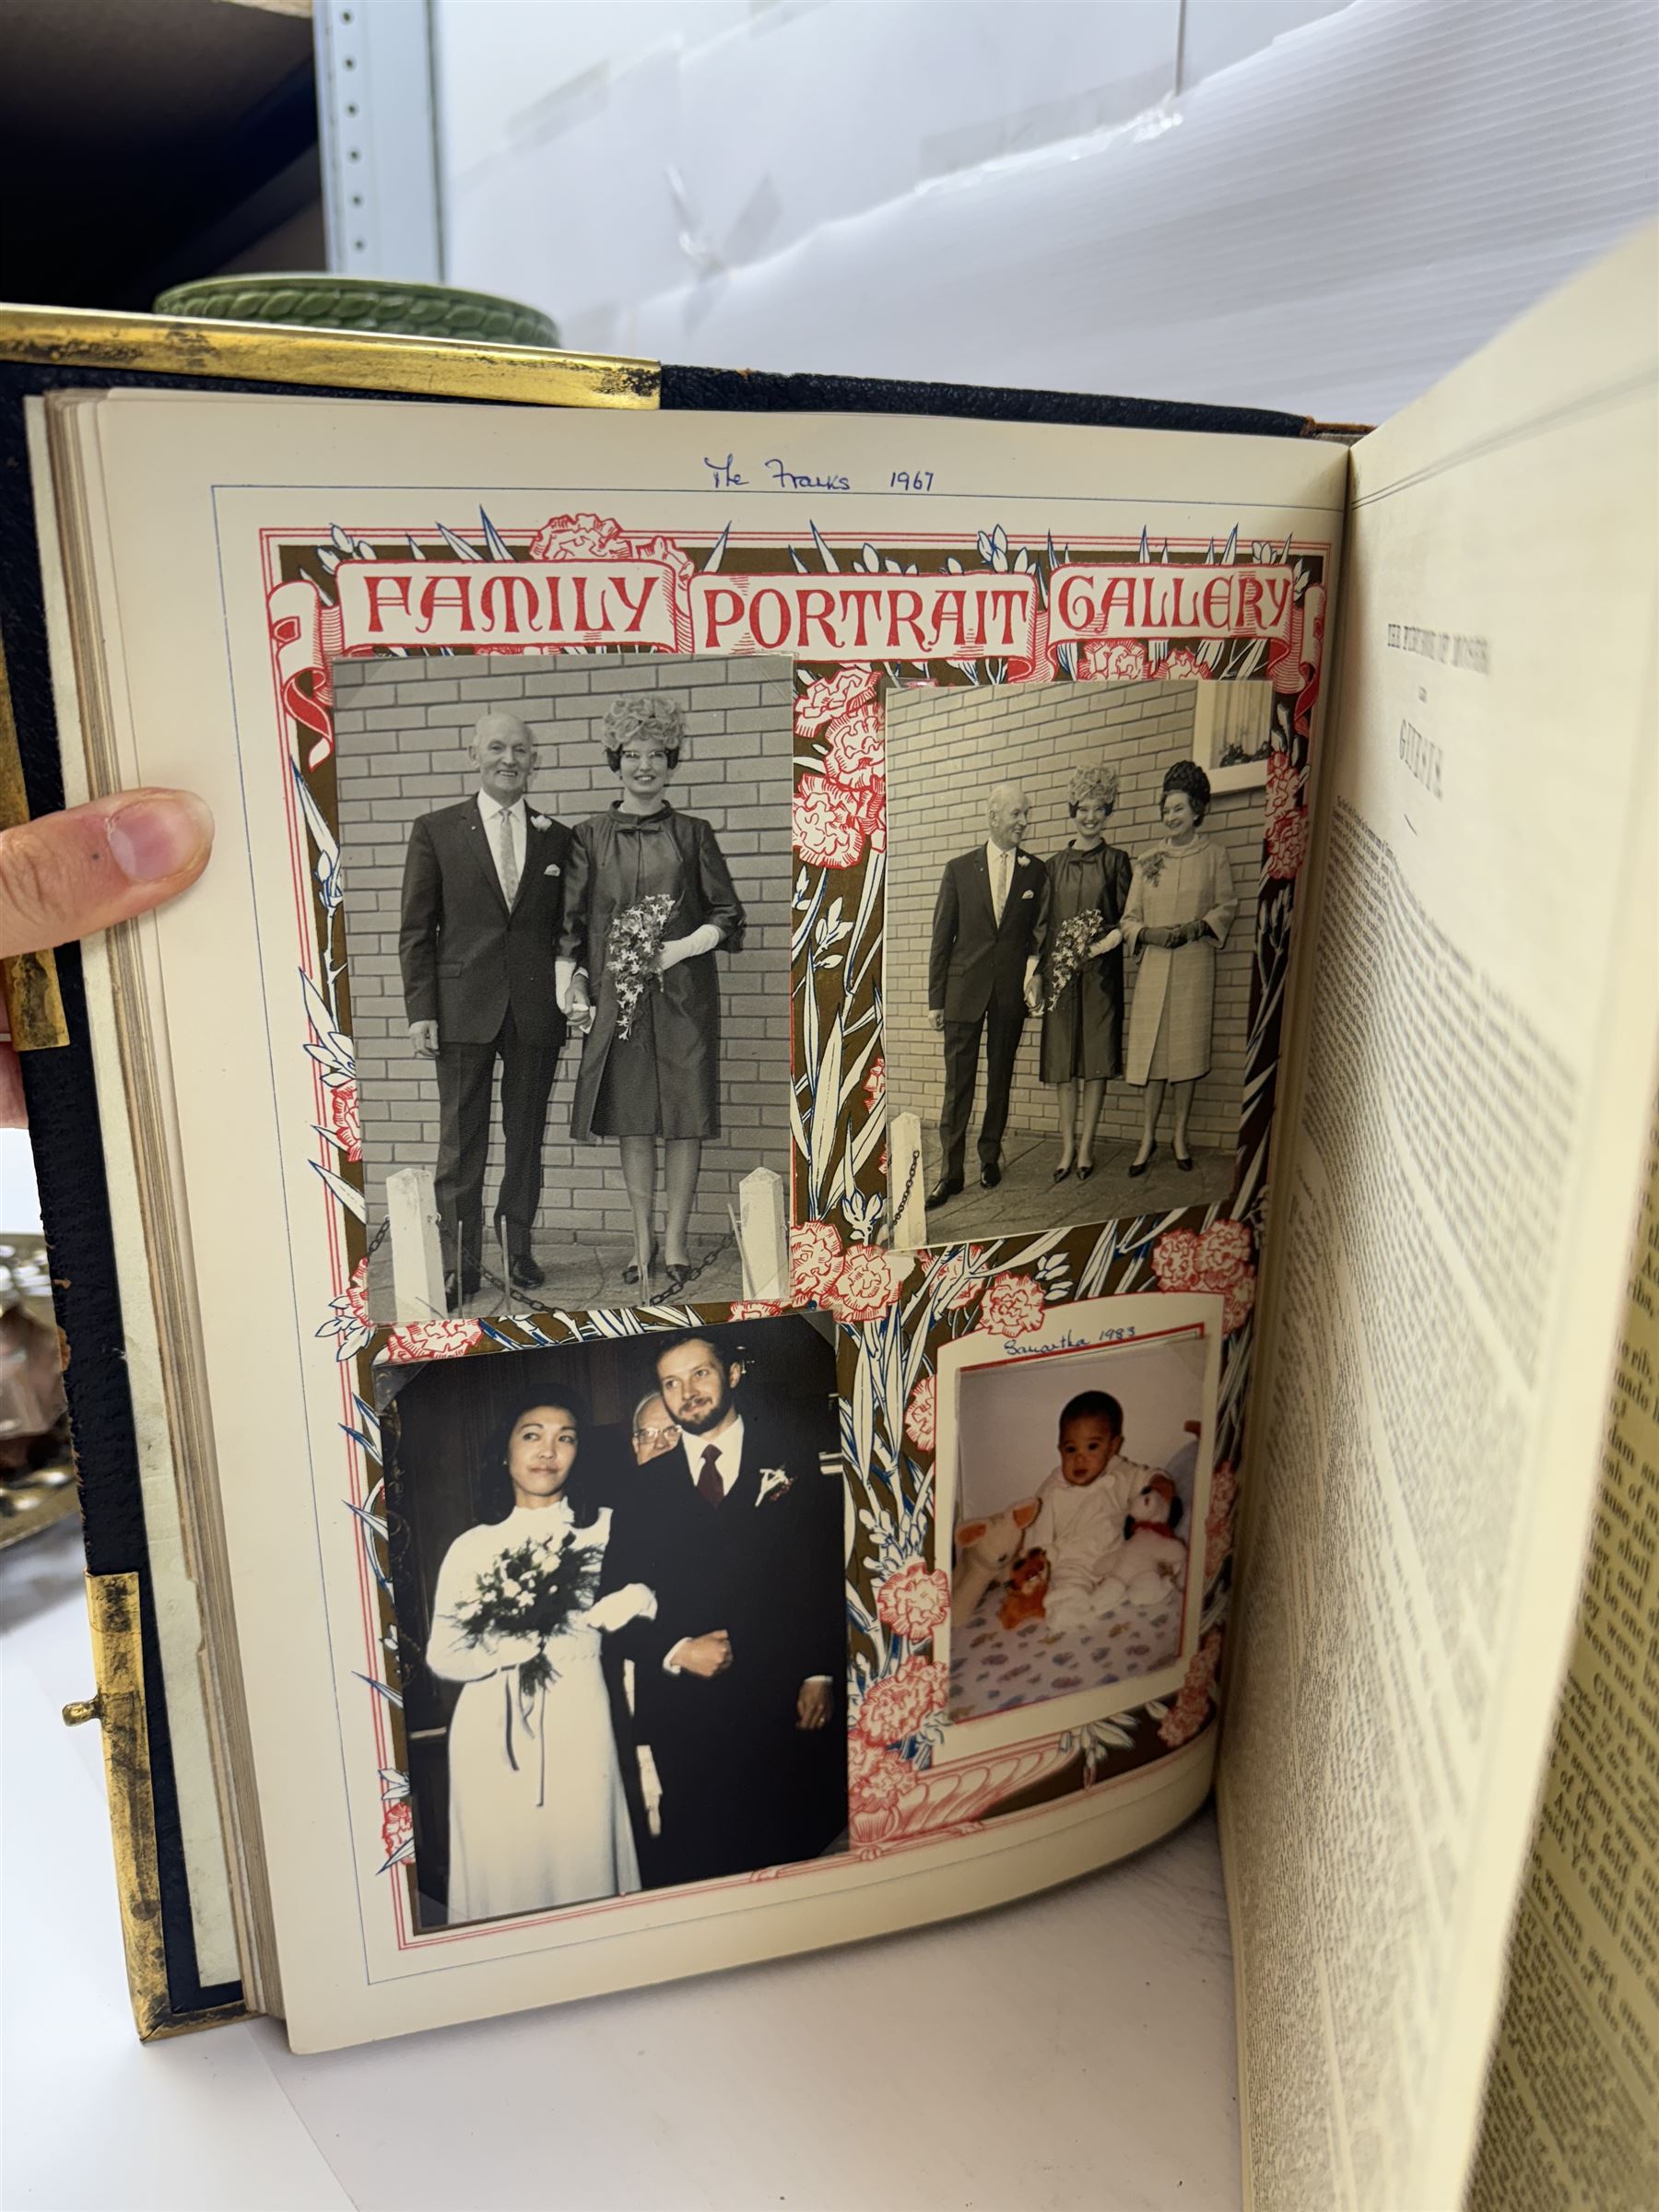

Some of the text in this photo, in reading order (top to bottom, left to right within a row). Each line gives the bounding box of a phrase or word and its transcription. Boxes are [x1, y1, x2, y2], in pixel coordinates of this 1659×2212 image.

[704, 453, 749, 488] The
[890, 471, 935, 491] 1967
[365, 574, 1294, 651] FAMILY PORTRAIT GALLERY
[1099, 1326, 1136, 1342] 1983
[1554, 1792, 1580, 1839] And
[1582, 1831, 1595, 1865] he
